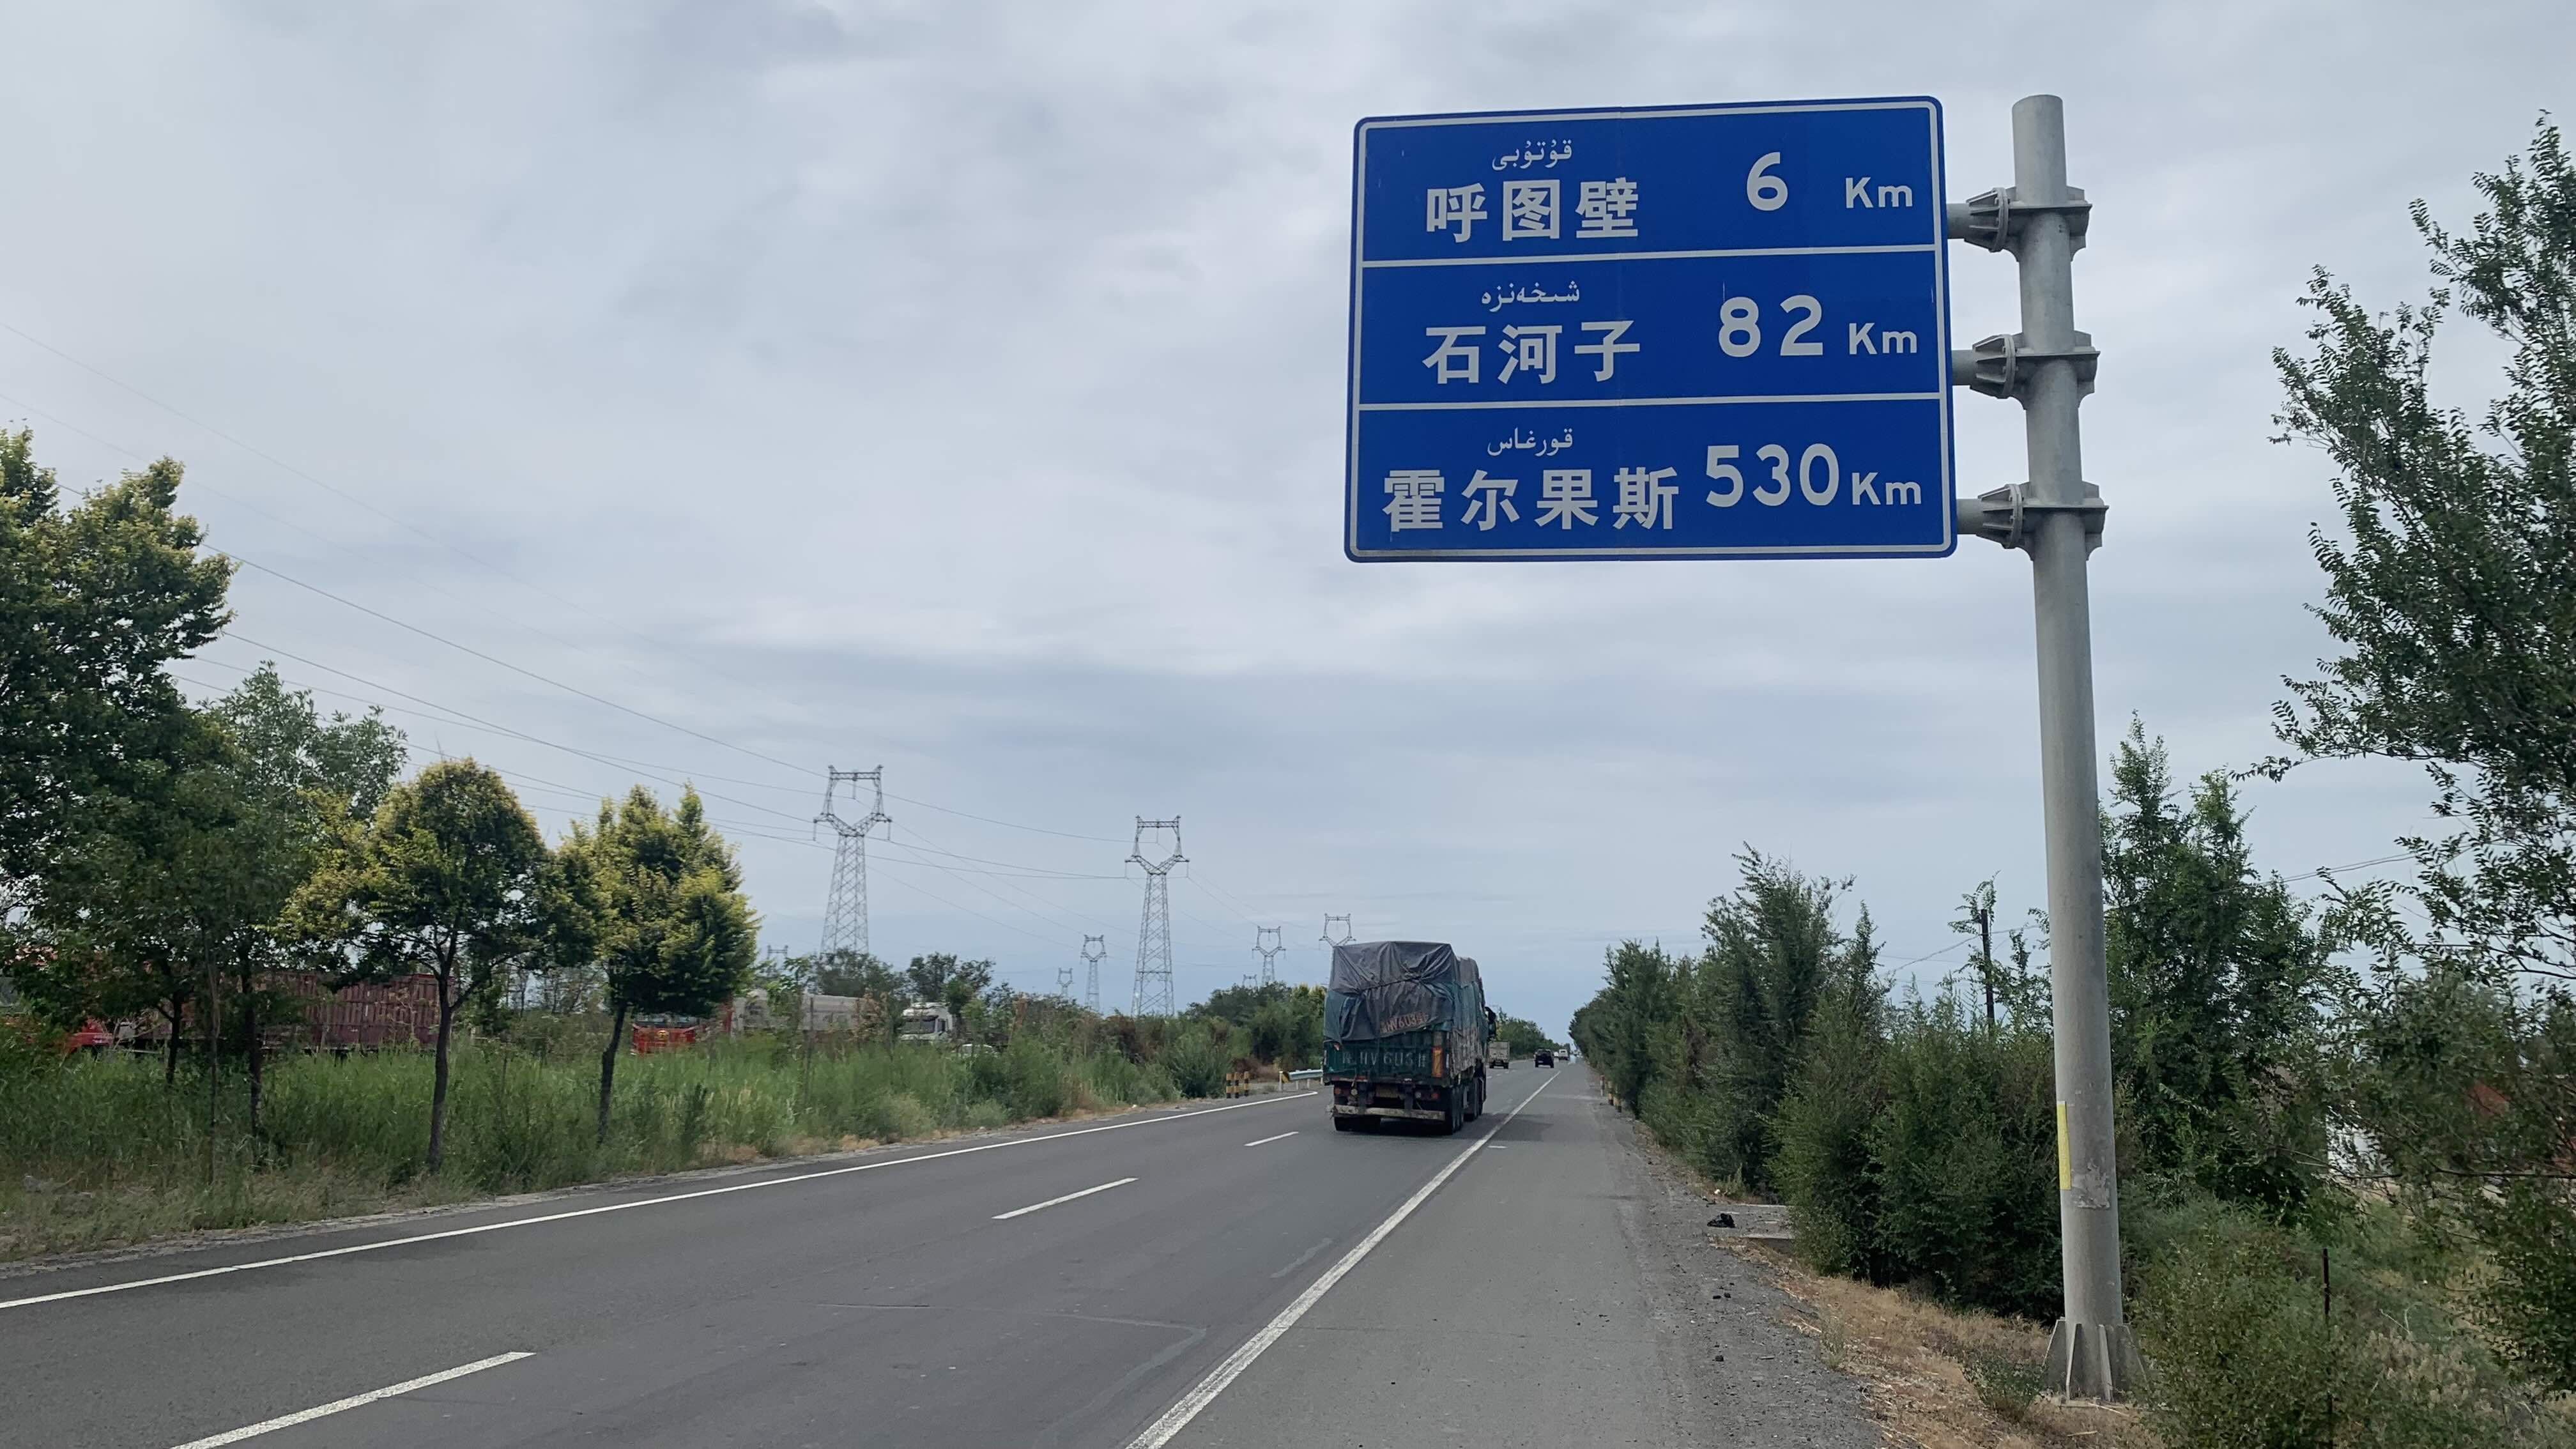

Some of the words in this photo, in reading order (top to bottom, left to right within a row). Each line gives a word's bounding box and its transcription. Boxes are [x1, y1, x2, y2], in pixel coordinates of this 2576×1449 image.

[1426, 176, 1639, 243] 呼图壁
[1746, 151, 1789, 211] 6
[1845, 176, 1913, 210] Km
[1422, 320, 1641, 385] 石河子
[1718, 295, 1824, 358] 82
[1849, 322, 1918, 355] Km
[1382, 466, 1680, 533] 霍尔果斯
[1706, 443, 1840, 508] 530
[1851, 472, 1922, 506] Km
